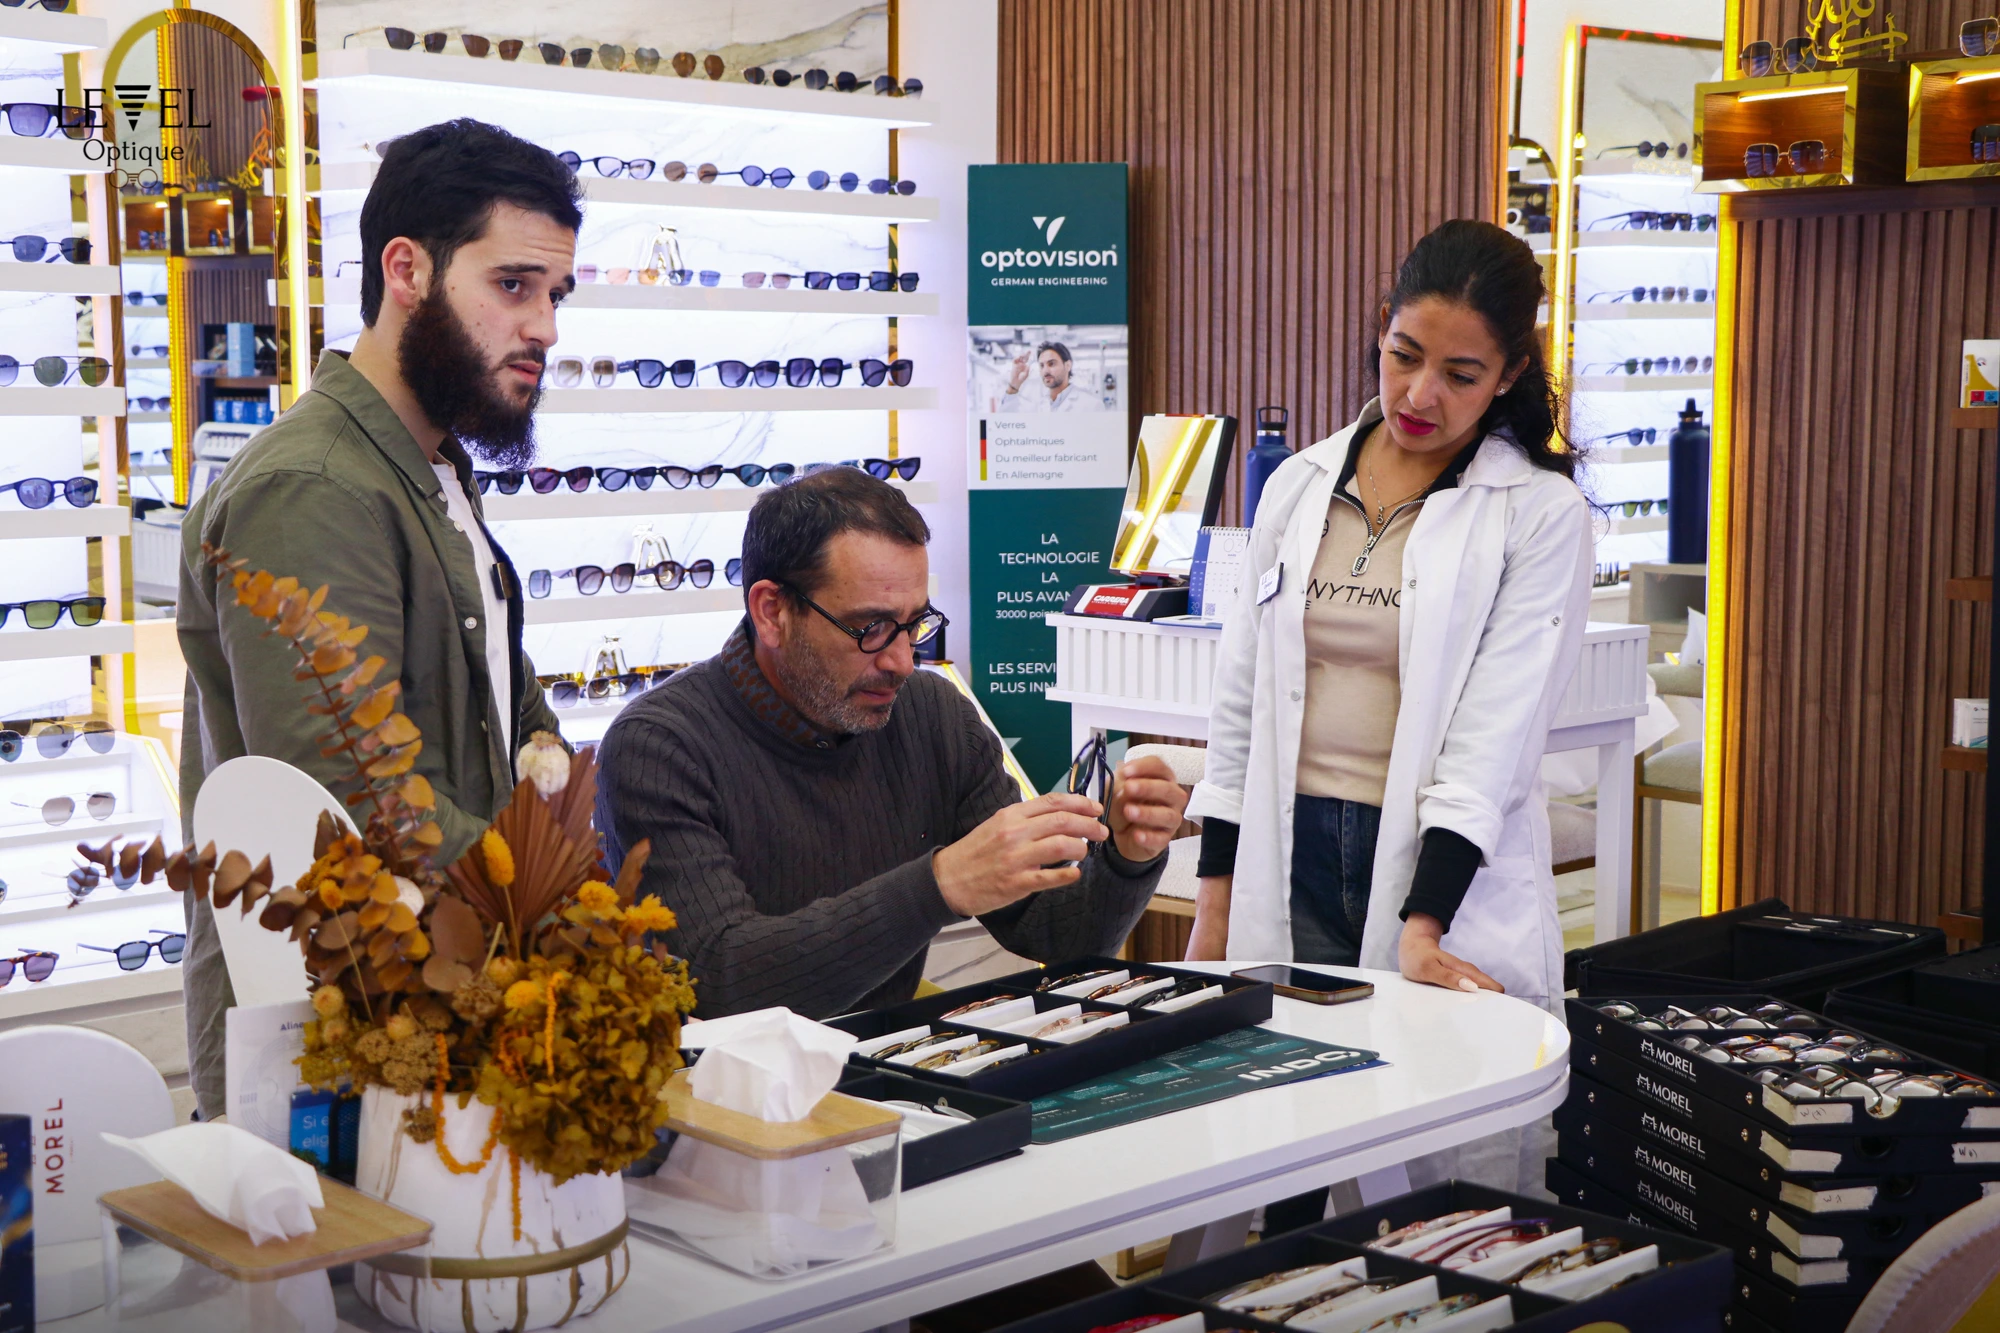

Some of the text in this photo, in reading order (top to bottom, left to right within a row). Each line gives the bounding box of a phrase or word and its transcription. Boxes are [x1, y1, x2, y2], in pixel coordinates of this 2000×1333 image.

[980, 248, 1118, 272] optovision
[991, 277, 1108, 286] GERMAN ENGINEERING
[994, 421, 1026, 429] Verres
[994, 436, 1065, 447] Ophtalmiques
[995, 453, 1097, 463] Du meilleur fabricant
[995, 470, 1064, 480] En Allemagne
[1041, 533, 1059, 545] LA
[998, 551, 1100, 565] TECHNOLOGIE
[1041, 572, 1059, 583] LA
[997, 591, 1033, 603] PLUS
[996, 609, 1027, 619] 30000
[989, 662, 1014, 675] LES
[990, 681, 1026, 693] PLUS
[1655, 1047, 1697, 1077] MOREL
[1651, 1081, 1693, 1113] MOREL
[303, 1115, 317, 1129] Si
[1658, 1121, 1706, 1154] MOREL
[44, 1098, 65, 1194] MOREL
[1651, 1155, 1696, 1189] MOREL
[1653, 1190, 1697, 1225] MOREL
